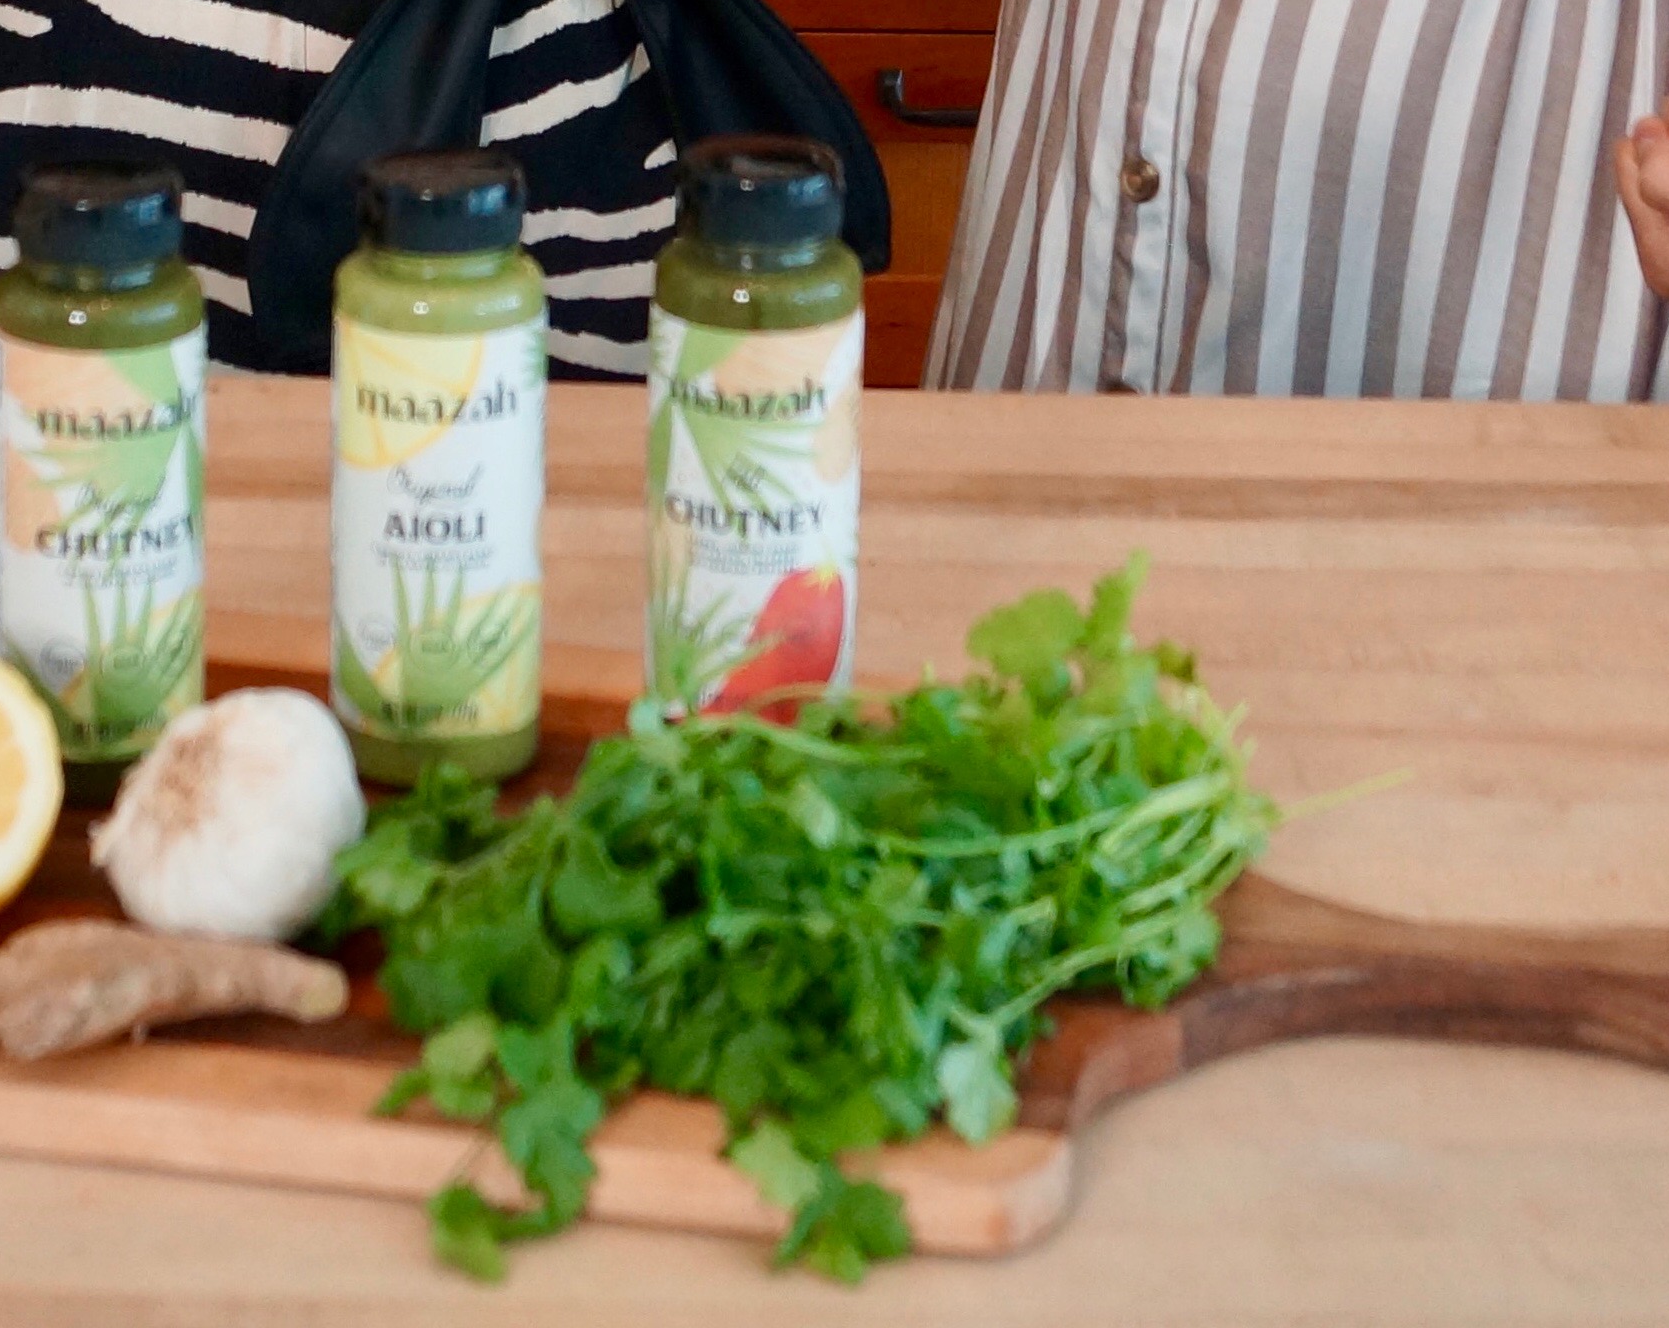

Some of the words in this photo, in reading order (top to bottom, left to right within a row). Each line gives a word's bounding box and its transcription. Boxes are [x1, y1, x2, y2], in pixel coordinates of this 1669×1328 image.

[35, 386, 196, 442] maazah
[356, 376, 518, 424] maazah
[669, 373, 826, 420] maazah
[383, 511, 487, 544] AIOLI
[664, 489, 824, 540] CHUTNEY
